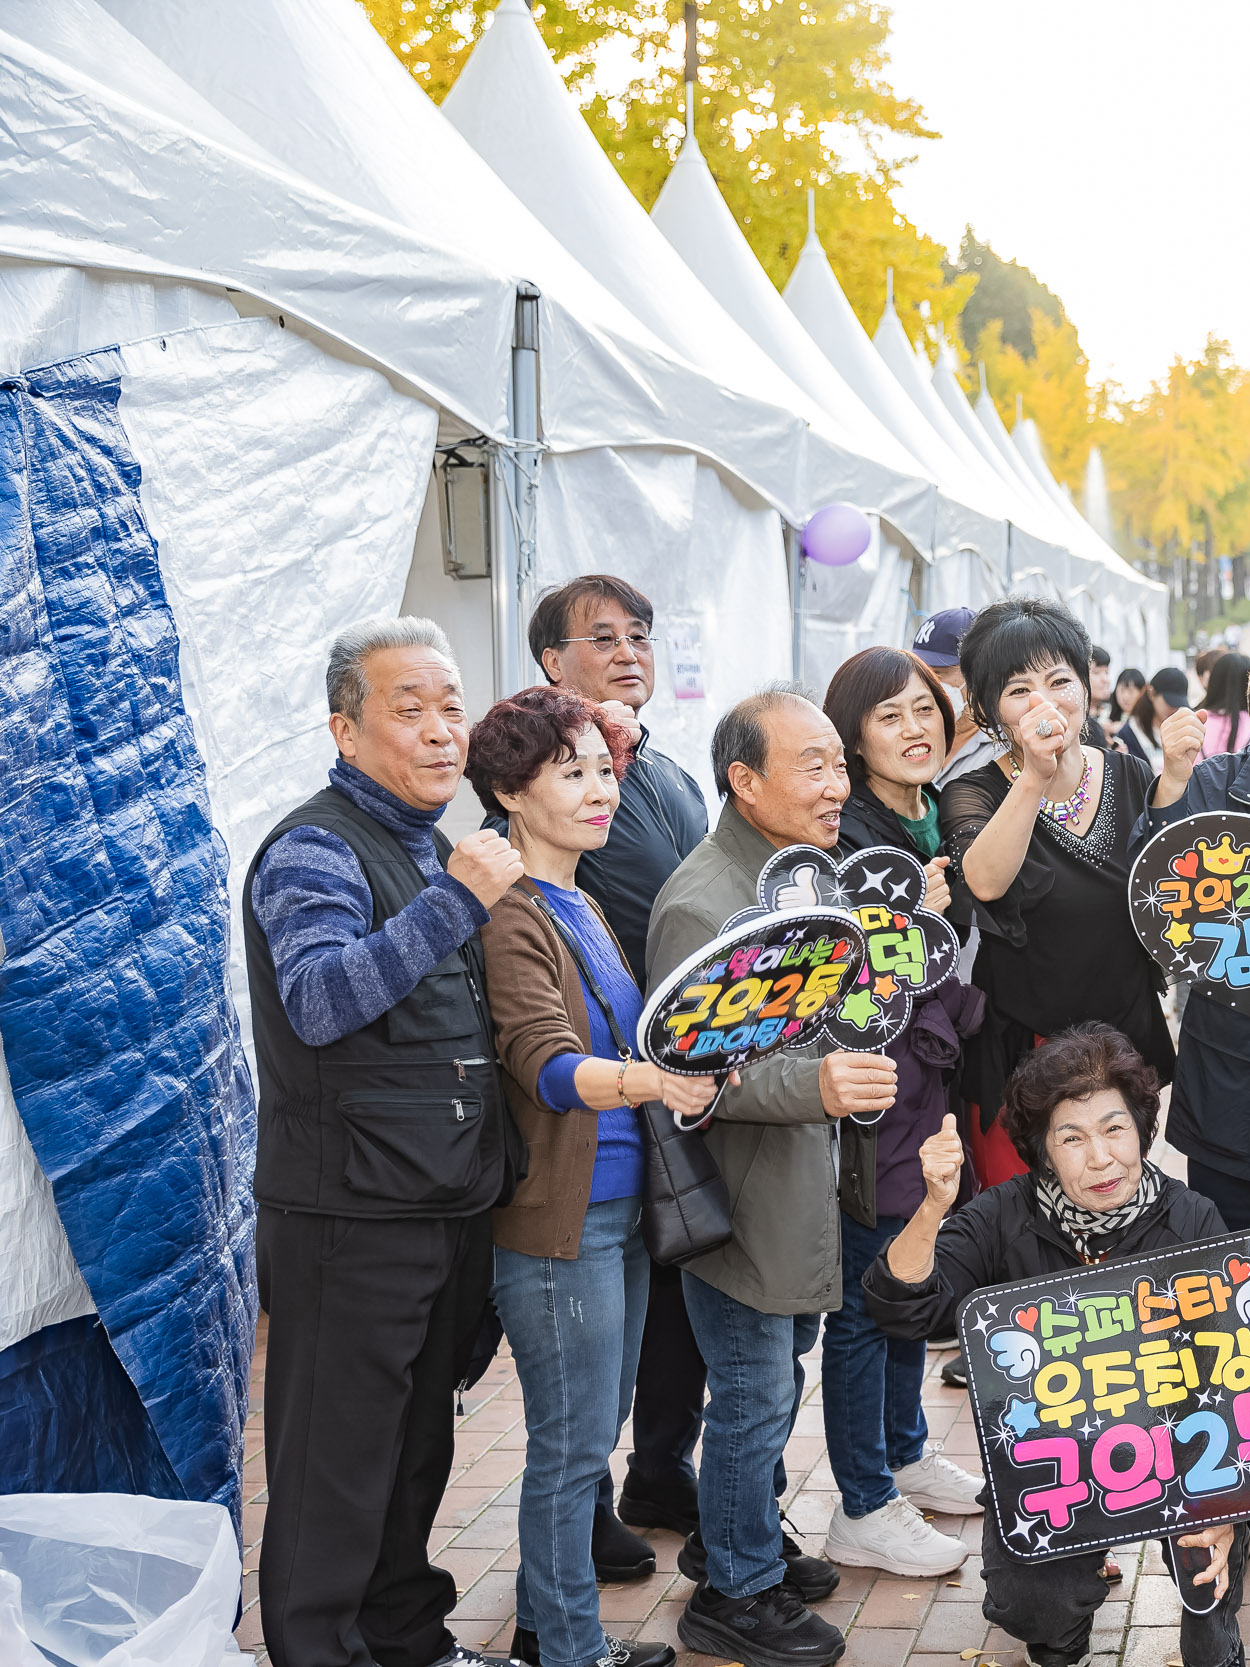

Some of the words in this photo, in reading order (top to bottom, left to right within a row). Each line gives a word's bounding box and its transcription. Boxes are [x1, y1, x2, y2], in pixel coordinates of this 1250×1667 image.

[728, 937, 836, 980] 빛이나는
[667, 963, 849, 1036] 구의2동
[688, 1016, 788, 1057] 파이팅
[1040, 1275, 1233, 1357] 슈퍼스타
